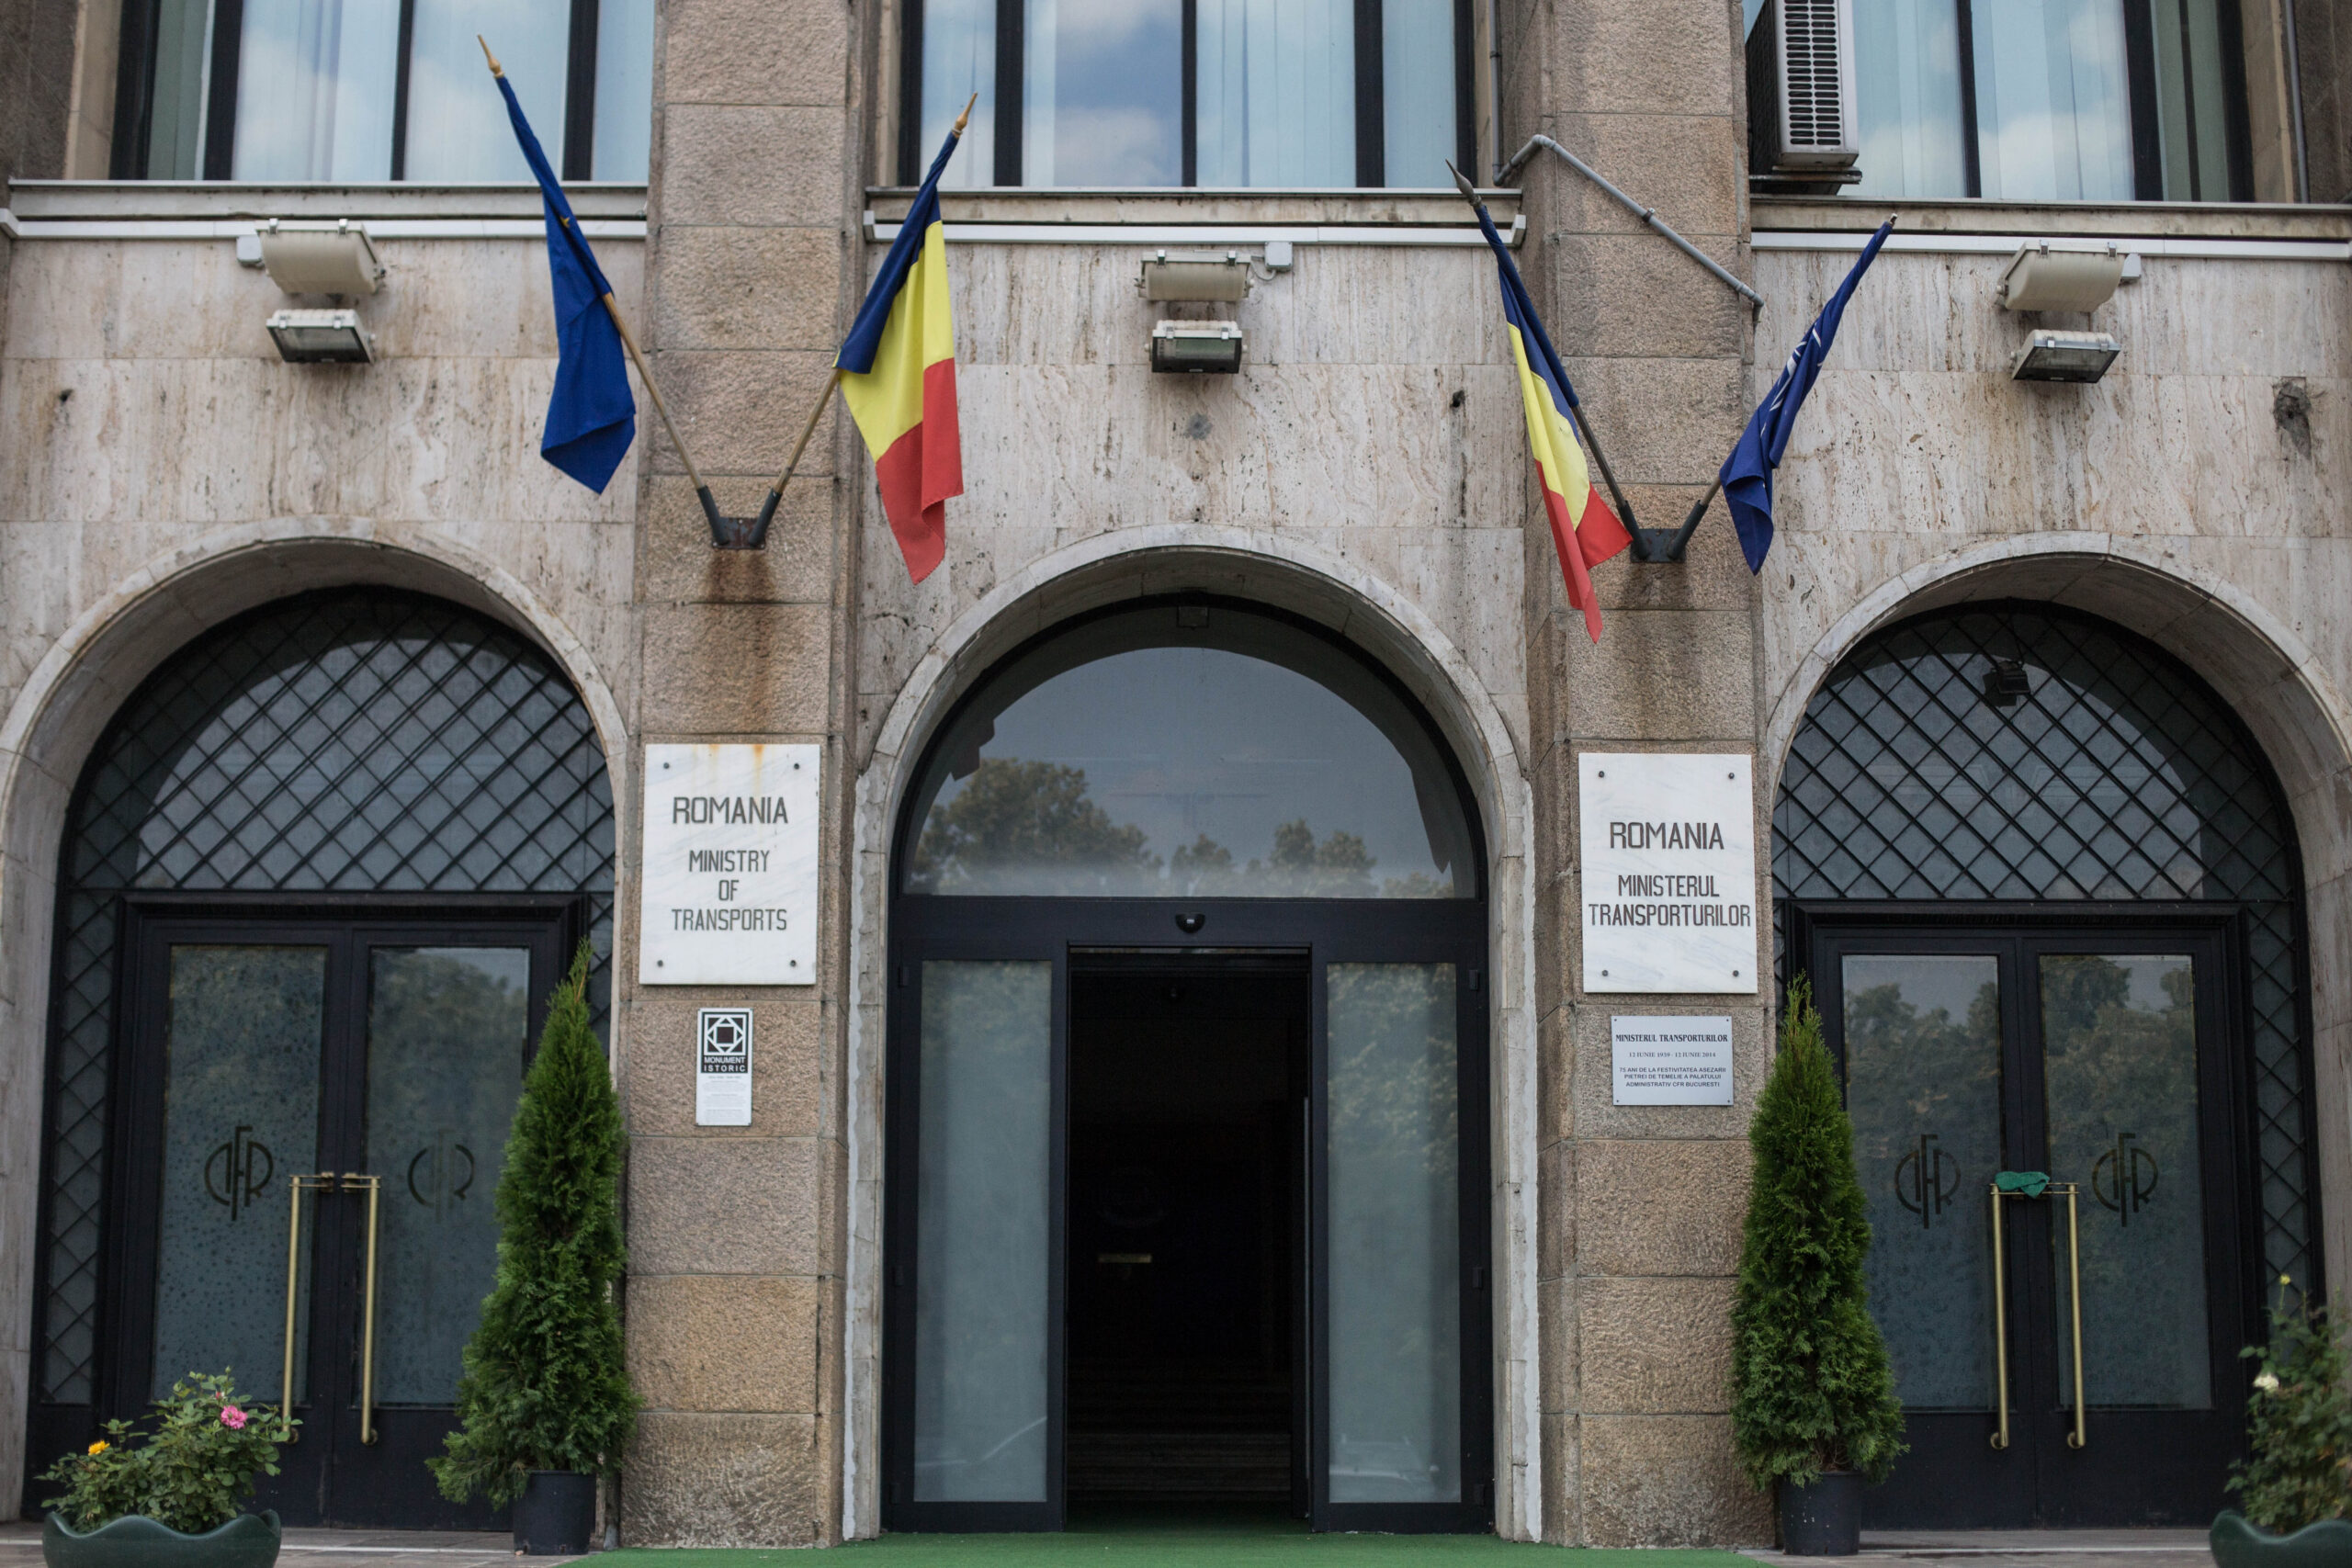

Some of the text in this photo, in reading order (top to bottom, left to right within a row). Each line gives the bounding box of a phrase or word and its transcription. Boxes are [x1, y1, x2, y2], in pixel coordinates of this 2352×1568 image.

[672, 796, 788, 824] ROMANIA
[1610, 821, 1724, 850] ROMANIA
[689, 850, 770, 872] MINISTRY
[718, 879, 739, 901] OF
[1618, 874, 1720, 897] MINISTERUL
[672, 908, 787, 931] TRANSPORTS
[1589, 903, 1751, 927] TRANSPORTURILOR
[1615, 1034, 1728, 1043] MINISTERUL TRANSPORTURILOR
